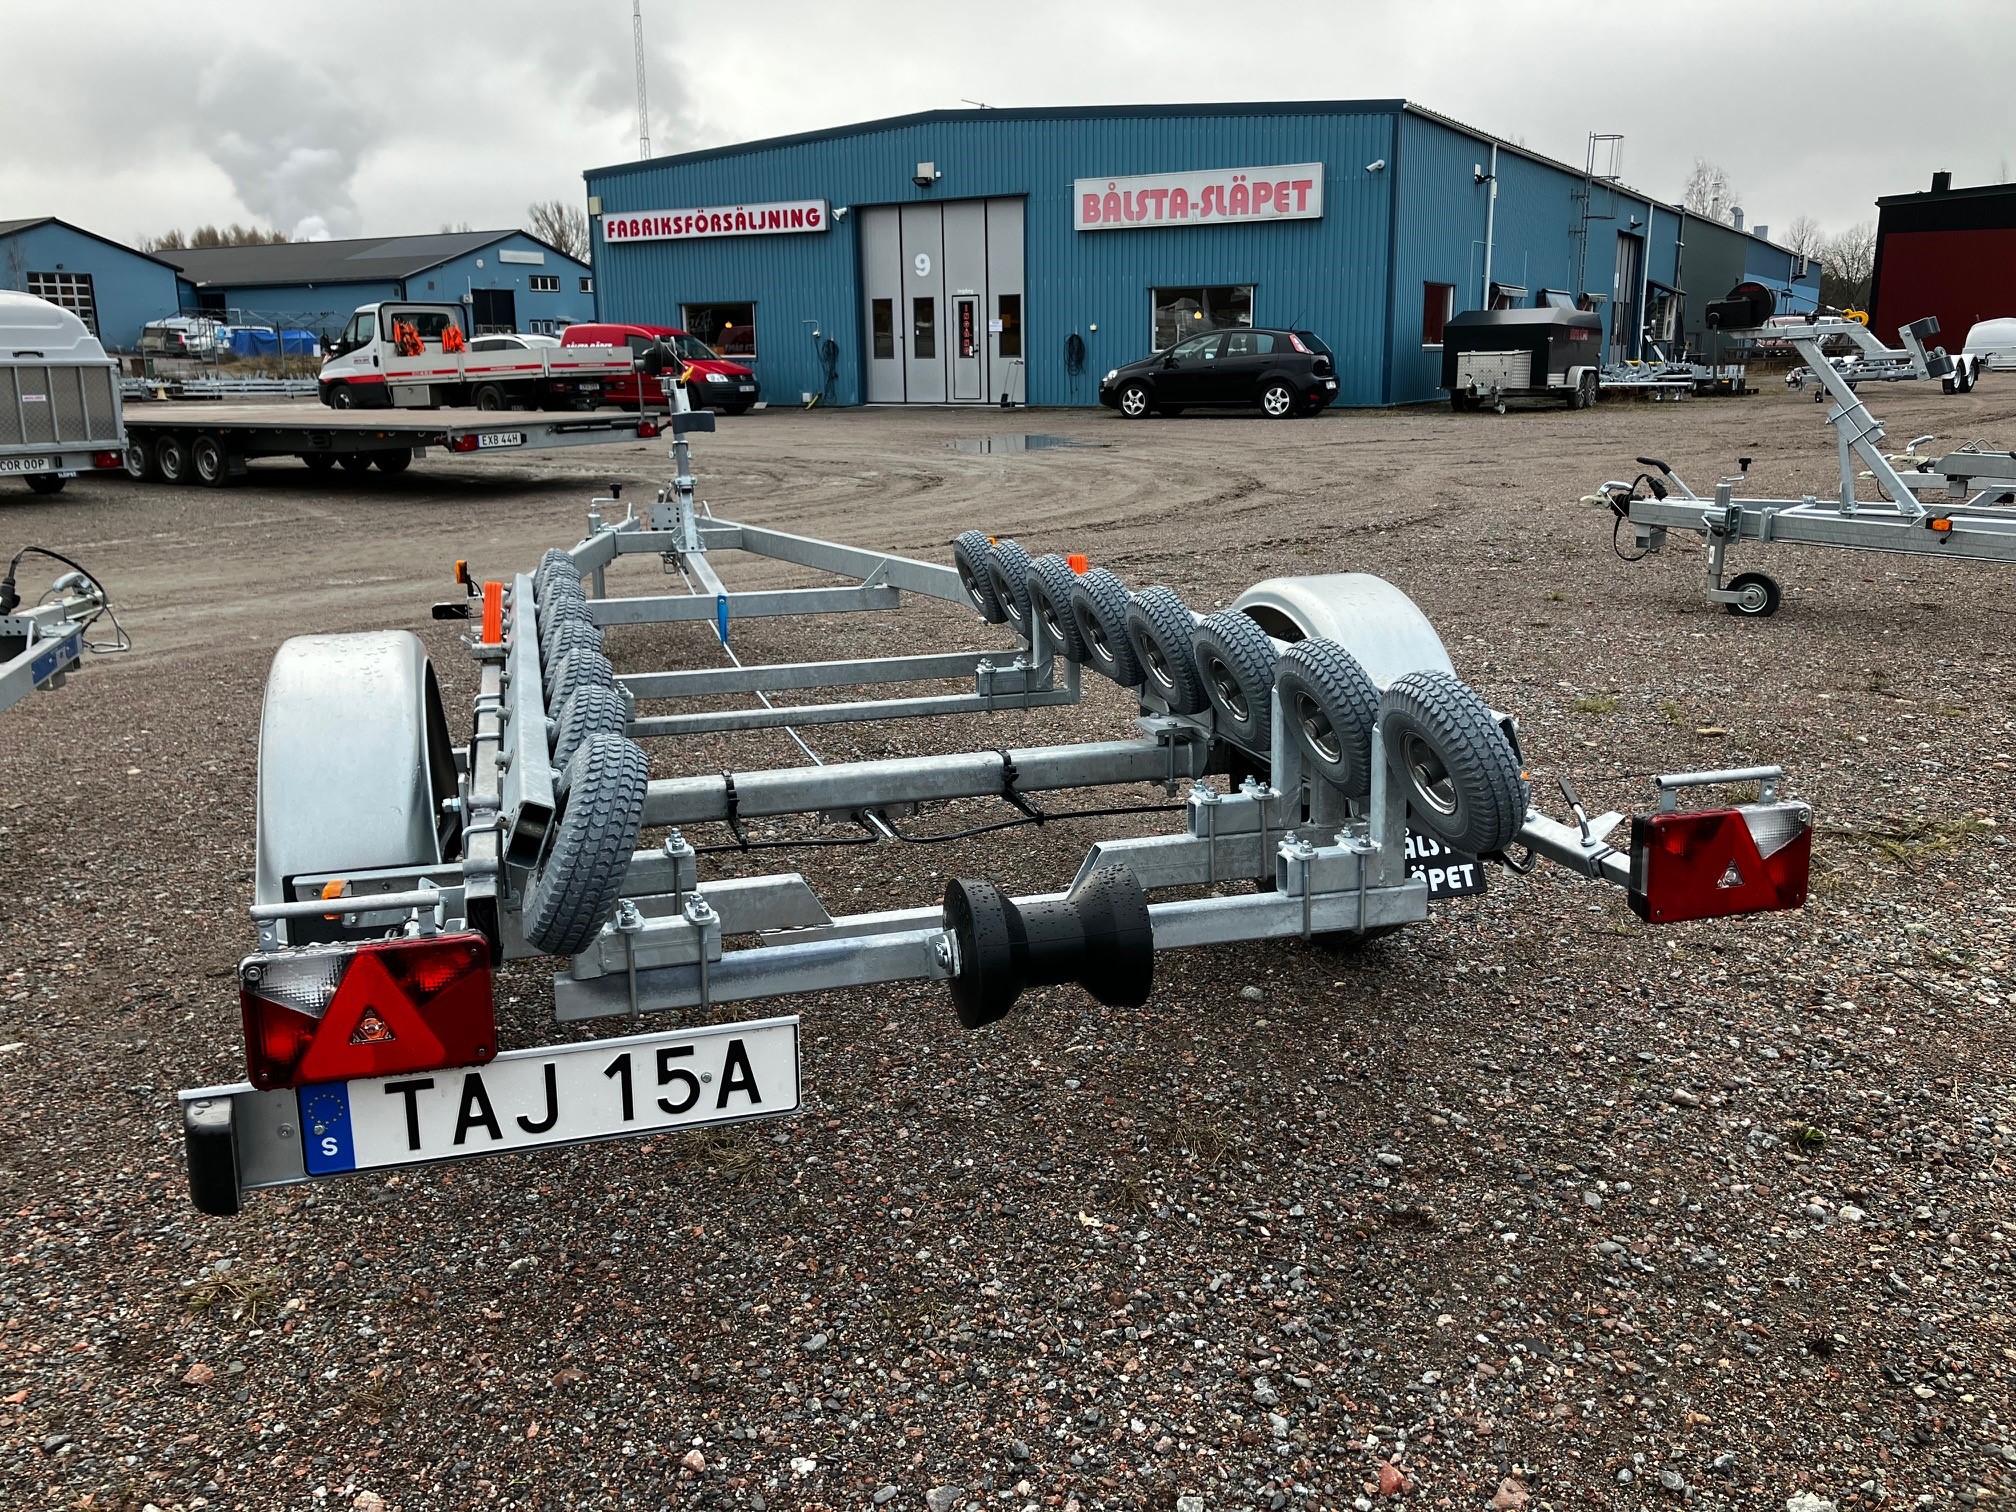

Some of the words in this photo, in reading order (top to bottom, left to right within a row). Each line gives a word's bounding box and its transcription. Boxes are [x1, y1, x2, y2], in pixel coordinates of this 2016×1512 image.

[1082, 174, 1313, 223] BÅLSTA-SLÄPET
[607, 206, 821, 239] FABRIKSFÖRSÄLJNING
[914, 253, 931, 277] 9
[963, 304, 971, 355] INGÅNG
[482, 435, 499, 445] EXB
[502, 434, 518, 444] 44H
[0, 460, 21, 471] COR
[384, 1062, 560, 1151] TAJ
[602, 1038, 763, 1121] 15A
[321, 1136, 339, 1157] S
